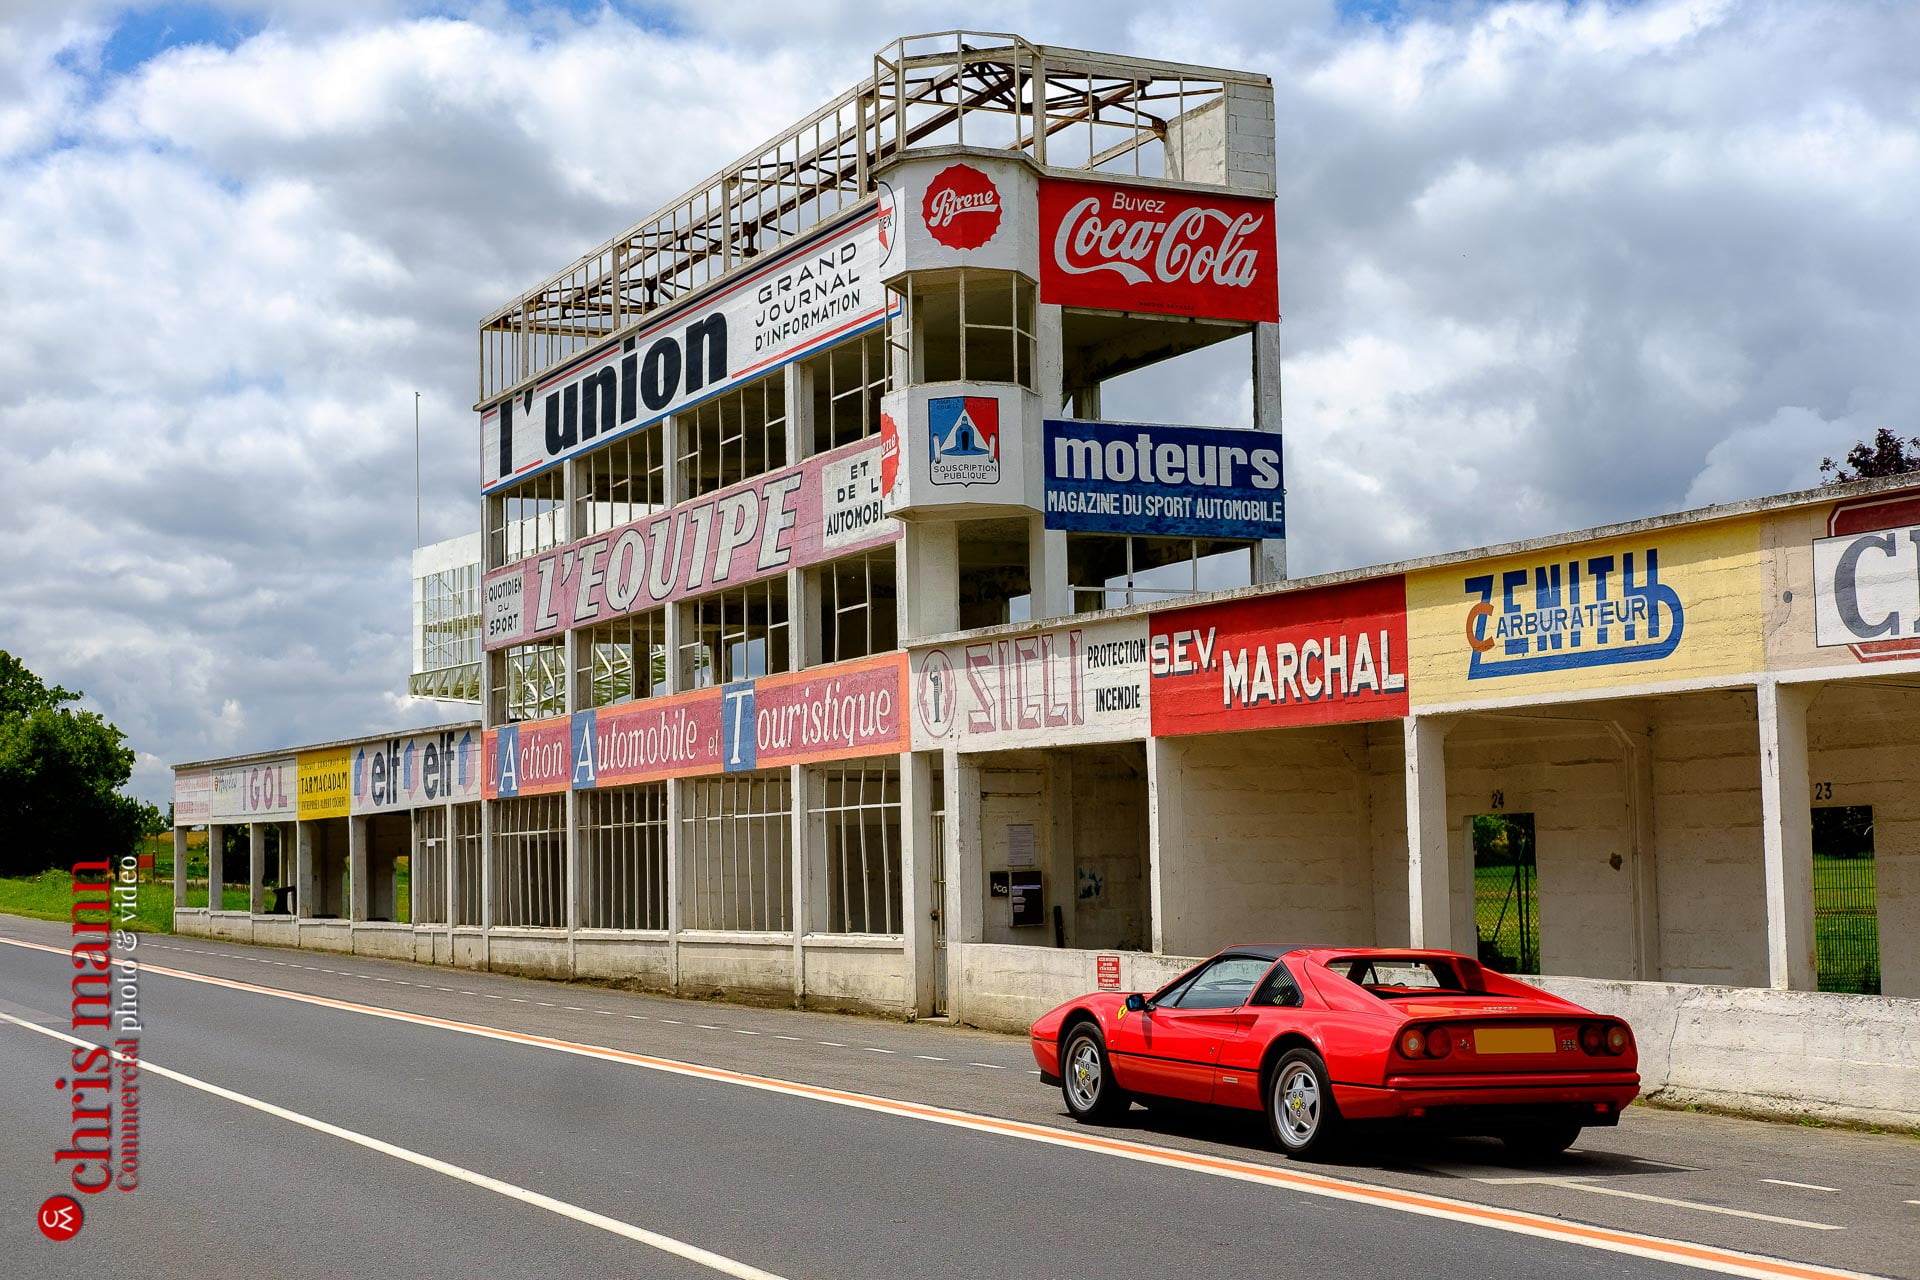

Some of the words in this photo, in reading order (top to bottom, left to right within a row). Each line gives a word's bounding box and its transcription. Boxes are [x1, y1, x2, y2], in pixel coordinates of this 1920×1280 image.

[928, 187, 998, 228] Pyrene
[1112, 192, 1166, 214] Buvez
[1054, 197, 1264, 288] Coca-Cola
[758, 242, 857, 303] GRAND
[755, 268, 861, 327] JOURNAL
[755, 288, 861, 352] D'INFORMATION
[500, 311, 728, 477] l'union
[850, 460, 869, 481] ET
[933, 463, 997, 473] SOUSCRIPTION
[943, 472, 987, 480] PUBLIQUE
[1055, 434, 1280, 490] moteurs
[837, 483, 857, 503] DE
[1047, 491, 1121, 516] MAGAZINE
[1123, 494, 1142, 516] DU
[1145, 495, 1193, 518] SPORT
[1196, 498, 1282, 523] AUTOMOBILE
[534, 471, 802, 631] L'EQUIPE
[488, 577, 522, 602] QUOTIDIEN
[1834, 530, 1920, 638] C
[489, 613, 518, 635] SPORT
[497, 602, 510, 612] DU
[1465, 549, 1683, 680] ZENITH
[1466, 595, 1647, 653] CARBURATEUR
[1087, 638, 1146, 668] PROTECTION
[1223, 630, 1406, 708] MARCHAL
[966, 629, 1085, 734] SICLI
[1095, 684, 1141, 713] INCENDIE
[572, 718, 697, 783] Automobile
[708, 732, 719, 757] et
[725, 688, 891, 765] Touristique
[243, 766, 287, 811] IGOL
[300, 771, 348, 794] TARMACADAM
[371, 740, 400, 806] elf
[423, 732, 454, 800] elf
[1491, 788, 1505, 809] 24
[1814, 782, 1833, 801] 23
